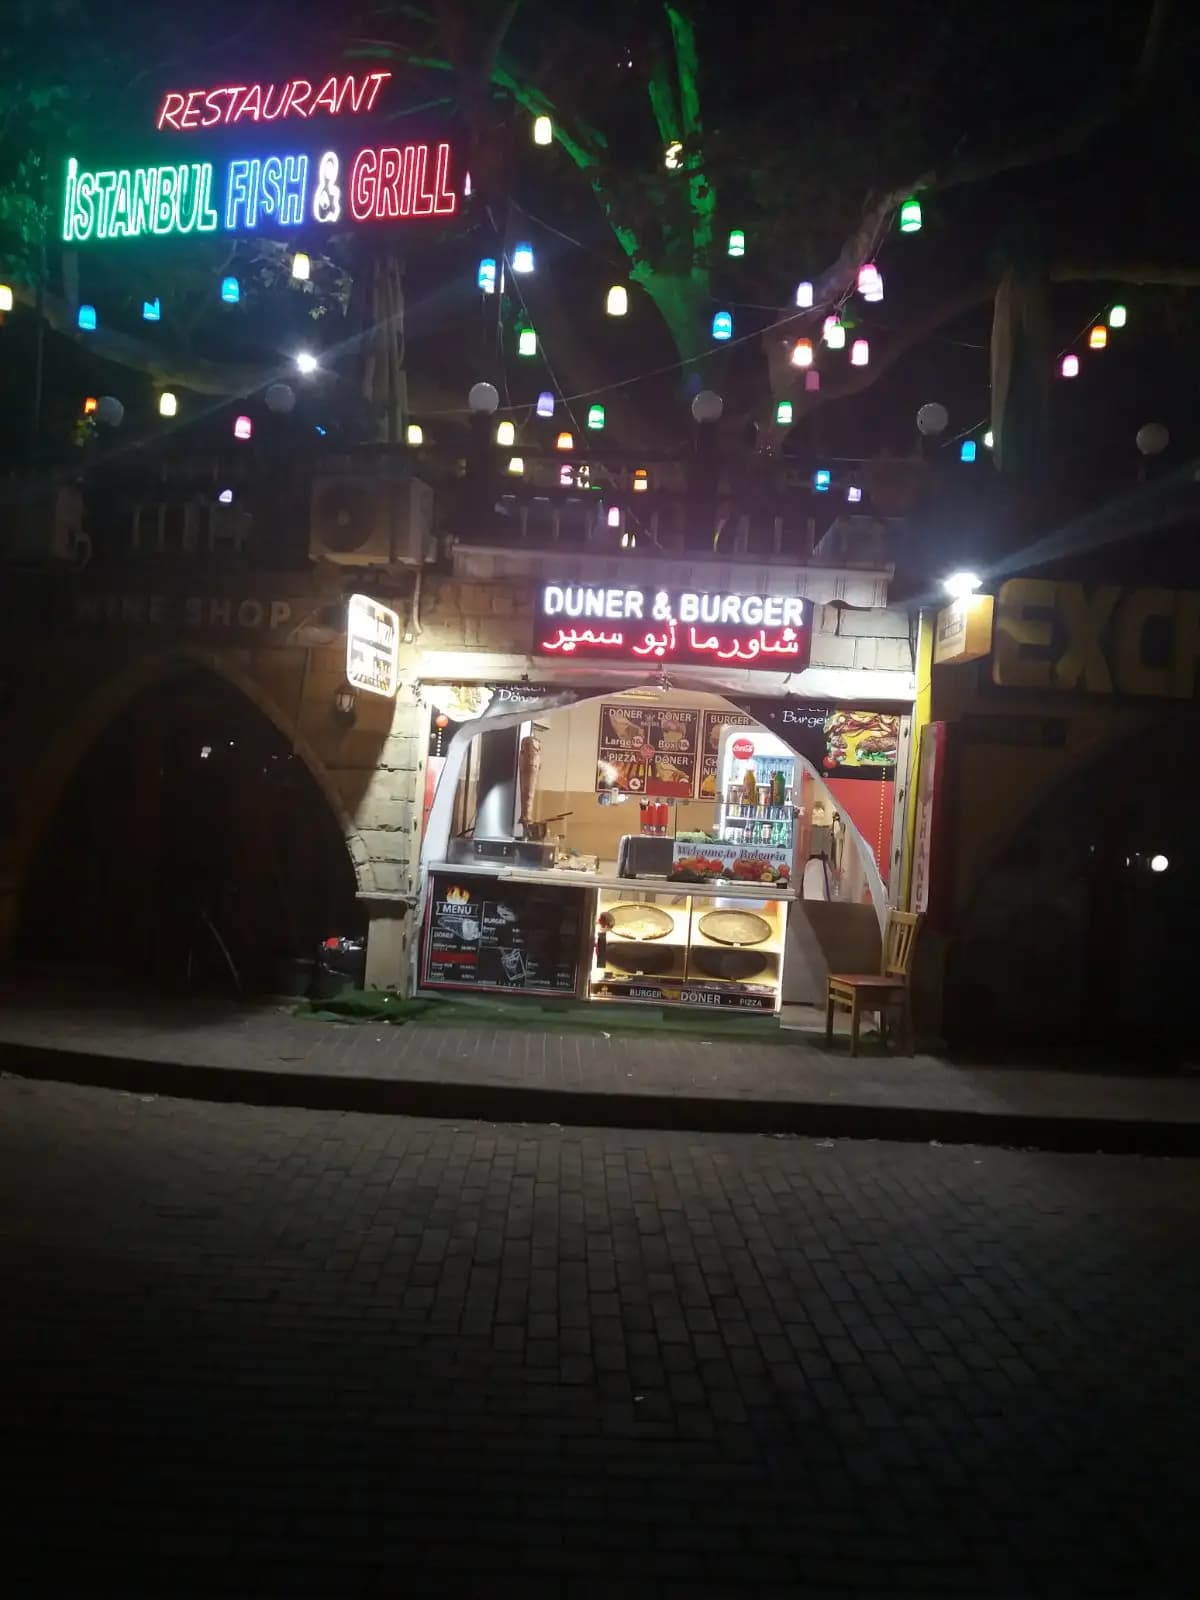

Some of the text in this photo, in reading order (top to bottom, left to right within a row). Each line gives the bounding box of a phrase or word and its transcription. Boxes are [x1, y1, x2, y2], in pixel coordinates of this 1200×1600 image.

[158, 73, 392, 130] RESTAURANT
[62, 143, 456, 241] İSTANBUL FISH & GRILL
[185, 597, 291, 629] SHOP
[543, 586, 804, 627] DUNER & BURGER
[542, 618, 799, 658] شاورما أبو سمير
[710, 714, 750, 725] BURGER
[605, 735, 631, 749] Large
[658, 739, 675, 749] Box
[608, 753, 637, 762] PIZZA
[677, 846, 723, 858] Welcome
[726, 848, 737, 858] to
[442, 904, 472, 914] MENU
[629, 988, 662, 998] BURGER
[739, 998, 762, 1007] PIZZA
